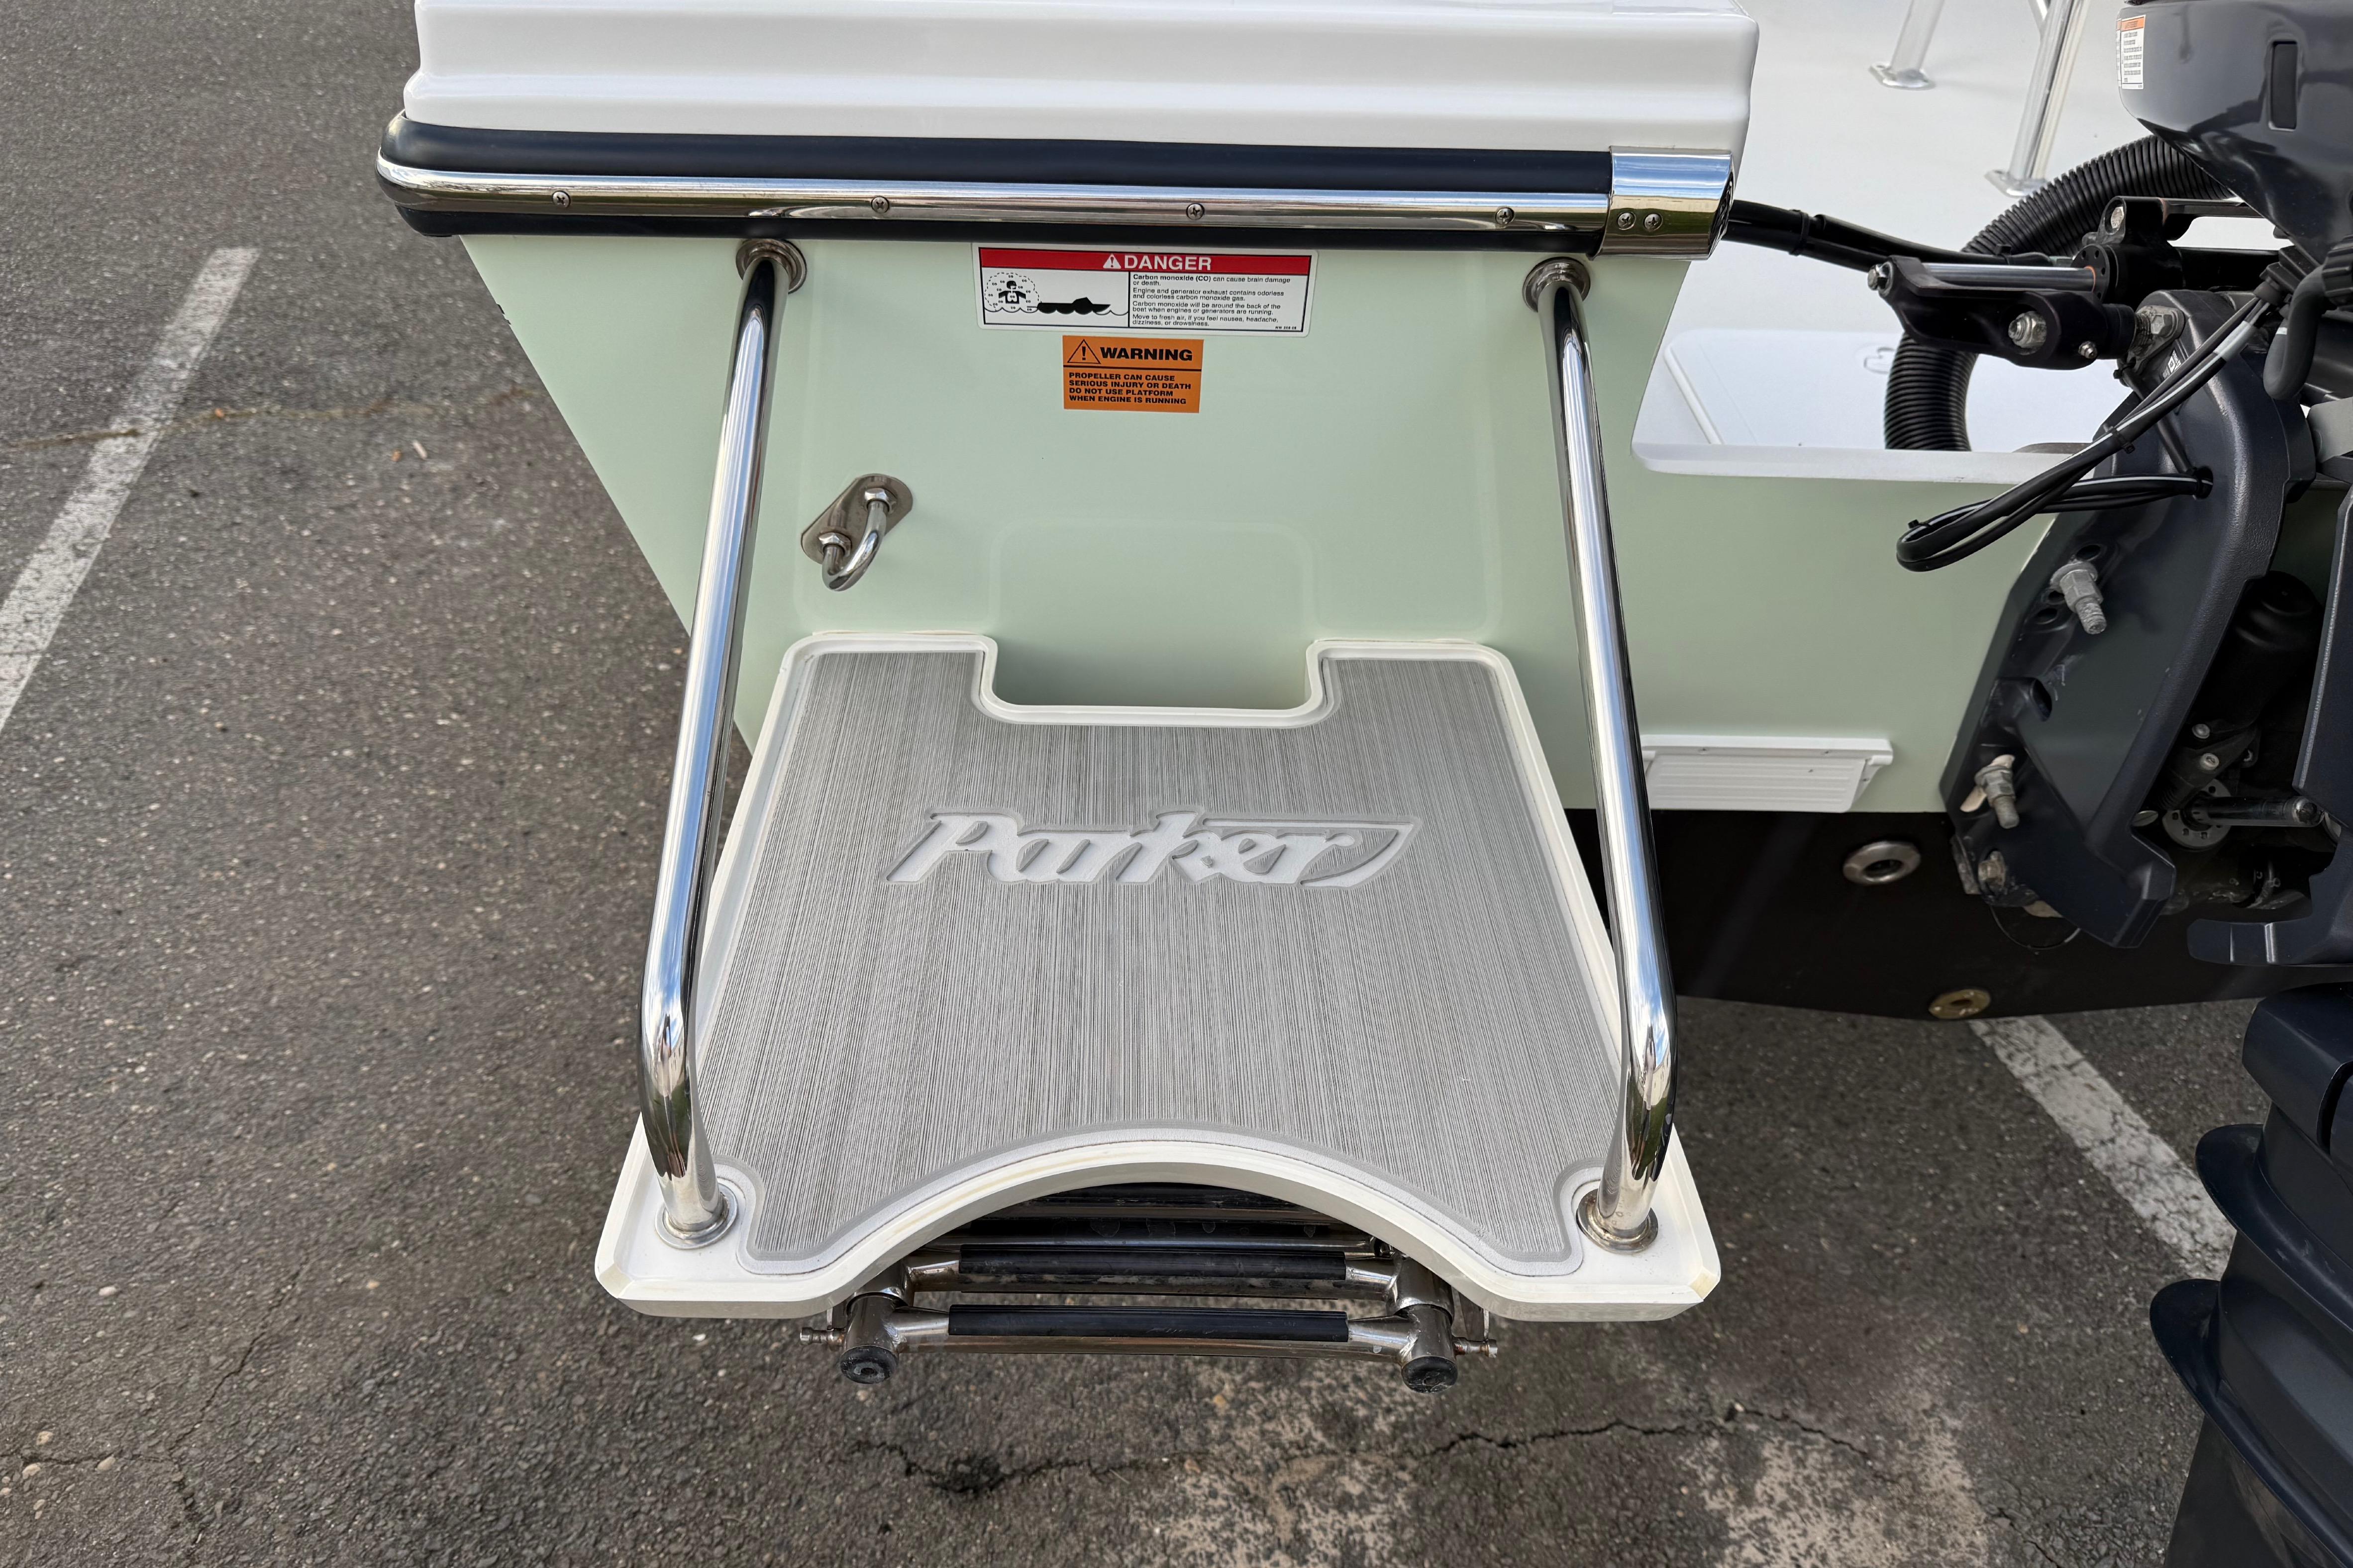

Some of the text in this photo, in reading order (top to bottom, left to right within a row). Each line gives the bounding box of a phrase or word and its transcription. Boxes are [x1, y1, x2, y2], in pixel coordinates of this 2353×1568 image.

[1125, 255, 1211, 270] DANGER
[1100, 347, 1193, 361] WARNING
[882, 810, 1418, 887] Parker
